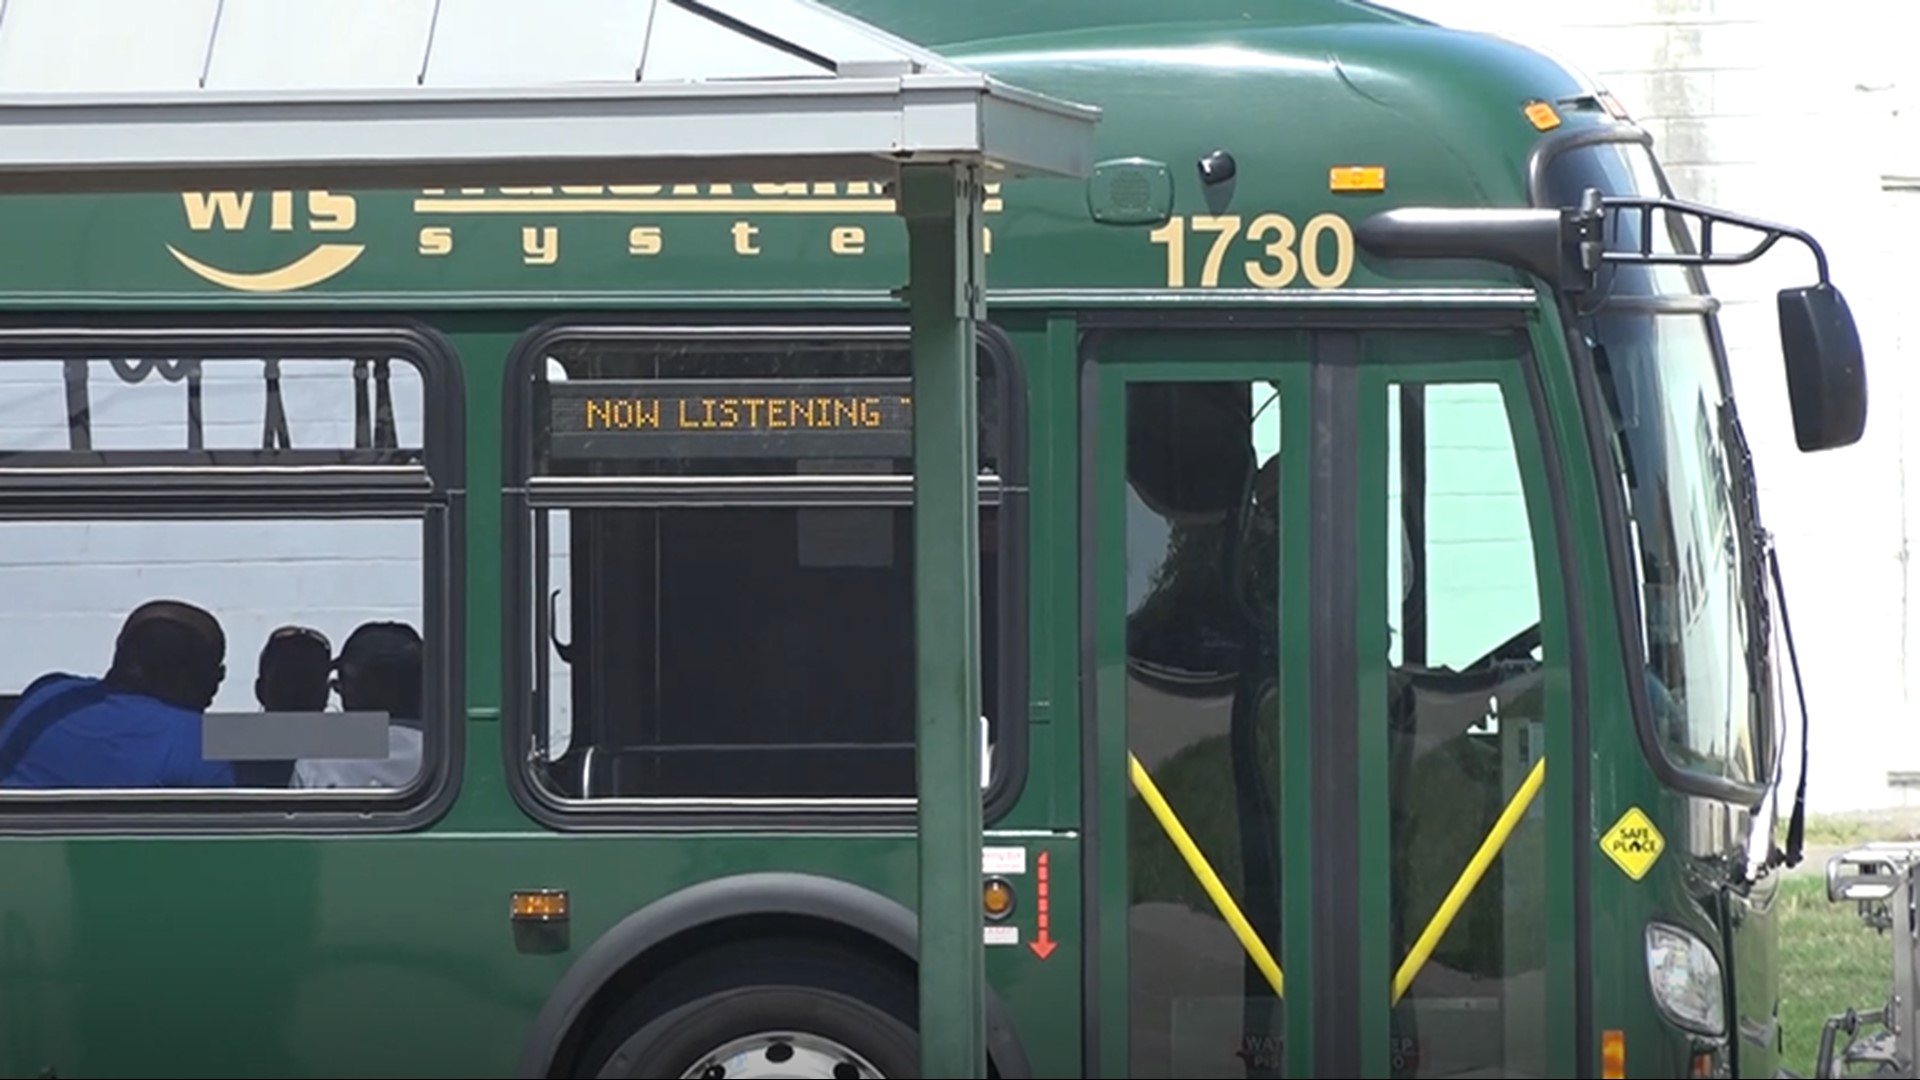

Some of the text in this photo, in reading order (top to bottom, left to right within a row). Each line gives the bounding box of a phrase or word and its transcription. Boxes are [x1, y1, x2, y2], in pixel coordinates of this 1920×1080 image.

[418, 221, 992, 265] syste
[1150, 213, 1355, 289] 1730
[586, 399, 660, 429] NOW
[679, 398, 881, 428] LISTENING
[1620, 828, 1649, 840] SAFE
[1613, 840, 1656, 853] PLACE
[1246, 1035, 1284, 1052] WAT
